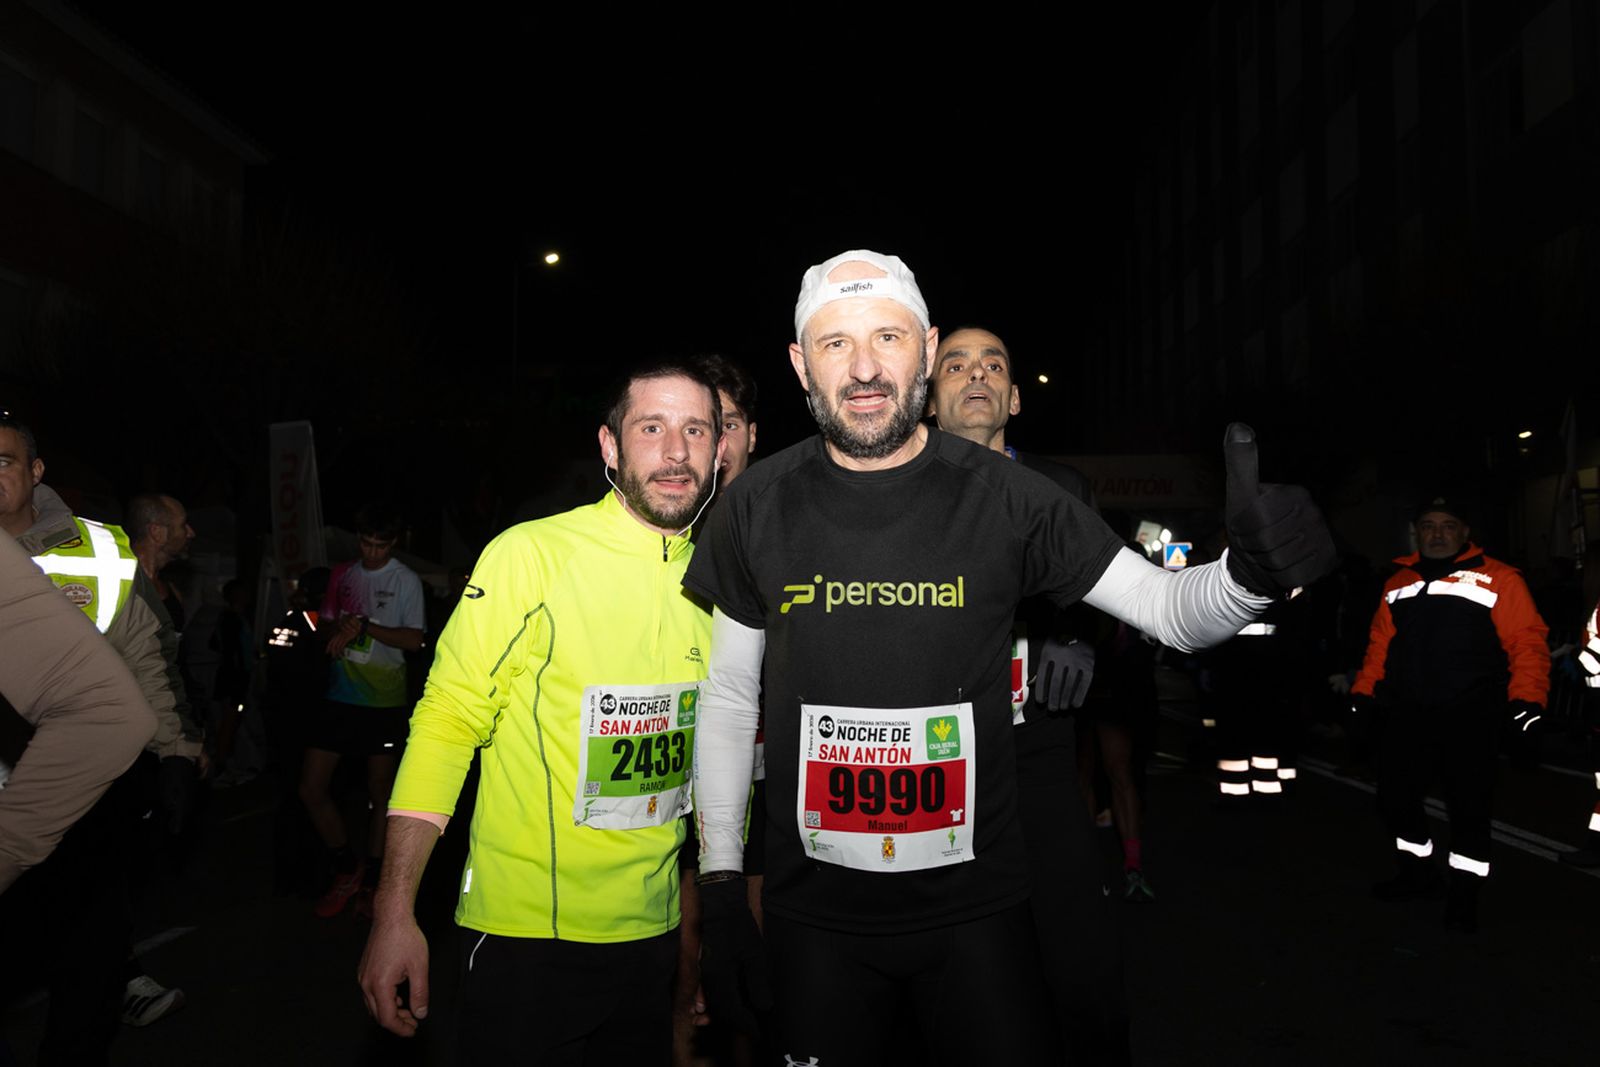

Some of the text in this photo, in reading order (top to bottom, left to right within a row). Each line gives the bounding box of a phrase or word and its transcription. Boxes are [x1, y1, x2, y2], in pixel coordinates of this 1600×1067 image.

[839, 282, 873, 293] sailfish
[825, 576, 965, 613] personal
[600, 698, 616, 710] 43
[618, 699, 671, 715] NOCHE DE
[599, 719, 631, 735] SAN
[633, 713, 670, 735] ANTÓN
[819, 720, 834, 732] 43
[837, 725, 911, 742] NOCHE DE
[610, 731, 686, 782] 2433
[819, 742, 911, 764] SAN ANTÓN
[828, 766, 945, 816] 9990
[867, 819, 908, 831] Manuel
